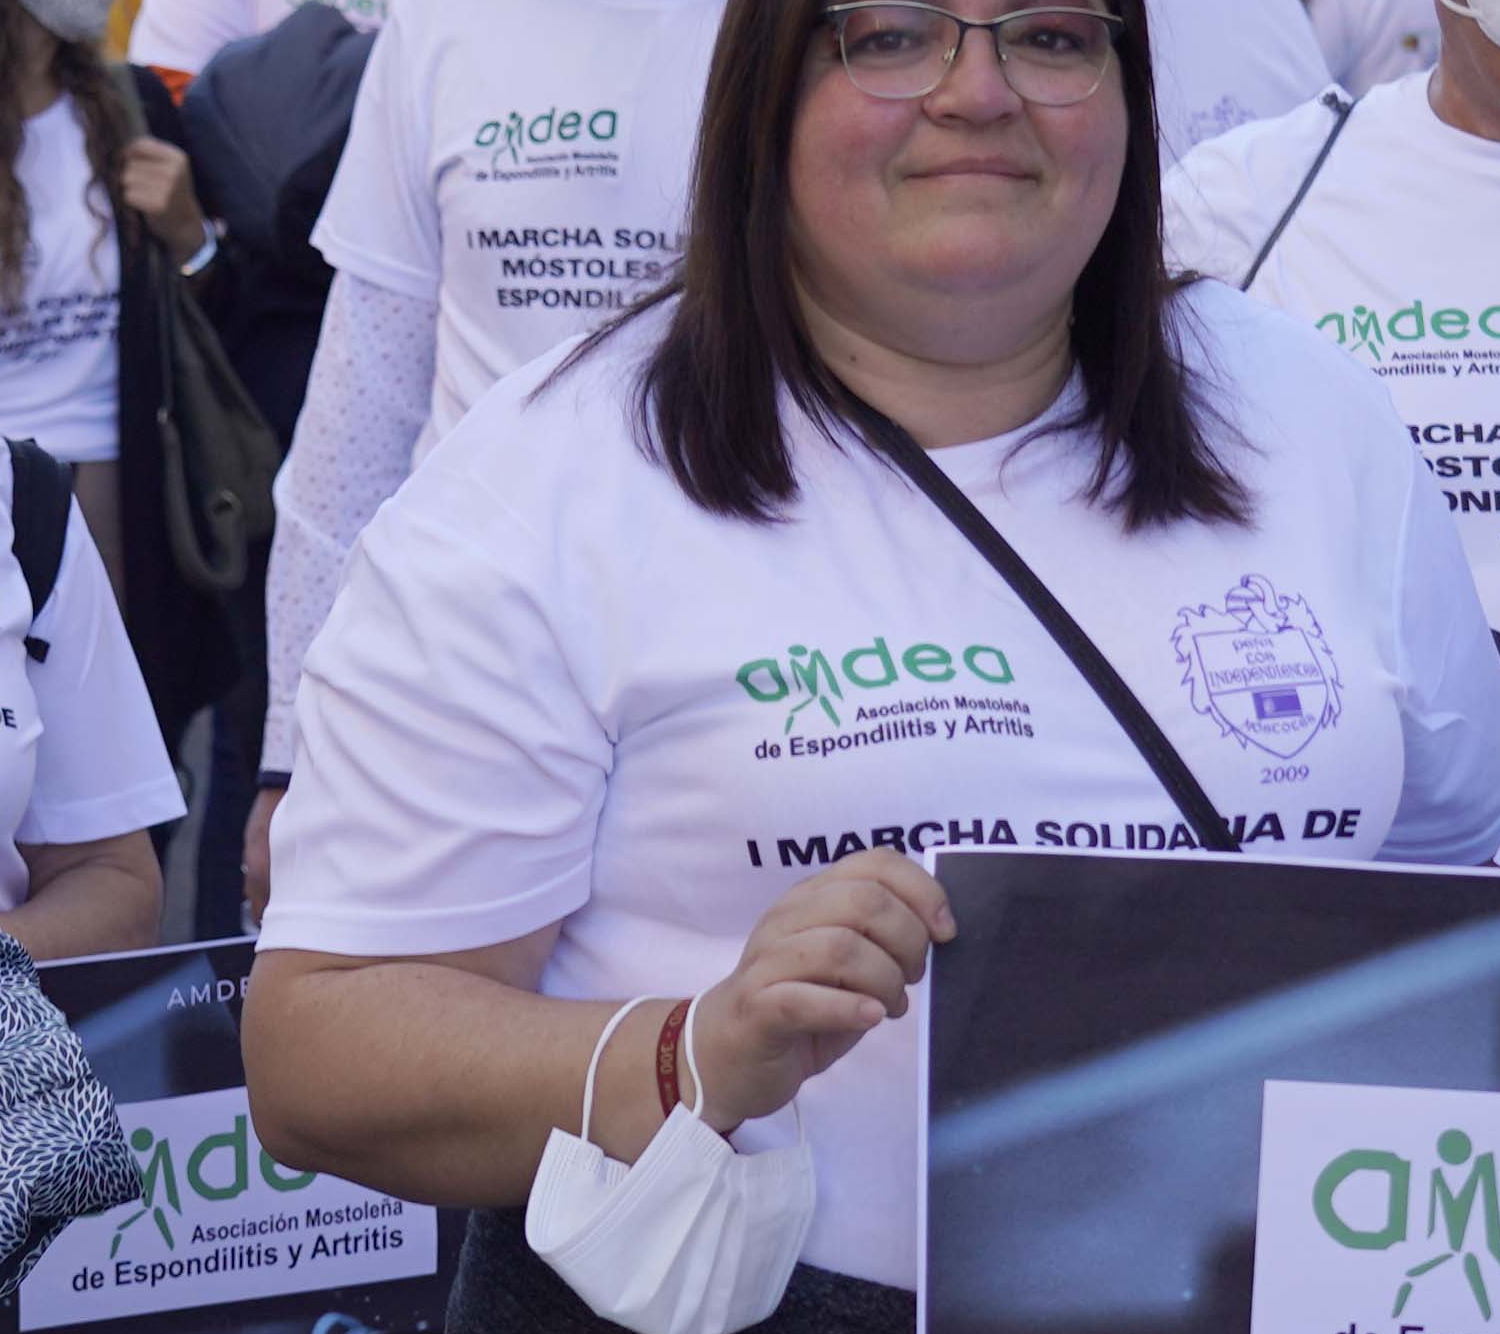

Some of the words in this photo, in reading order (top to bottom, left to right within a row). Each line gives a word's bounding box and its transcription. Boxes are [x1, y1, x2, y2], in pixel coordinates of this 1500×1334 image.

[478, 228, 603, 249] MARCHA
[856, 697, 951, 723] Asociación
[954, 696, 1031, 716] Mostoleña
[754, 740, 782, 761] de
[789, 718, 939, 760] Espondilitis
[944, 719, 958, 739] y
[964, 714, 1035, 740] Artritis
[1260, 764, 1310, 785] 2009
[746, 839, 764, 868] I
[1035, 809, 1286, 852] SOLIDAIA
[1301, 809, 1361, 840] DE
[192, 1213, 299, 1244] Asociación
[305, 1198, 404, 1229] Mostoleña
[72, 1266, 105, 1292] de
[115, 1244, 279, 1293] Espondilitis
[288, 1243, 304, 1269] y
[310, 1229, 404, 1260] Artritis
